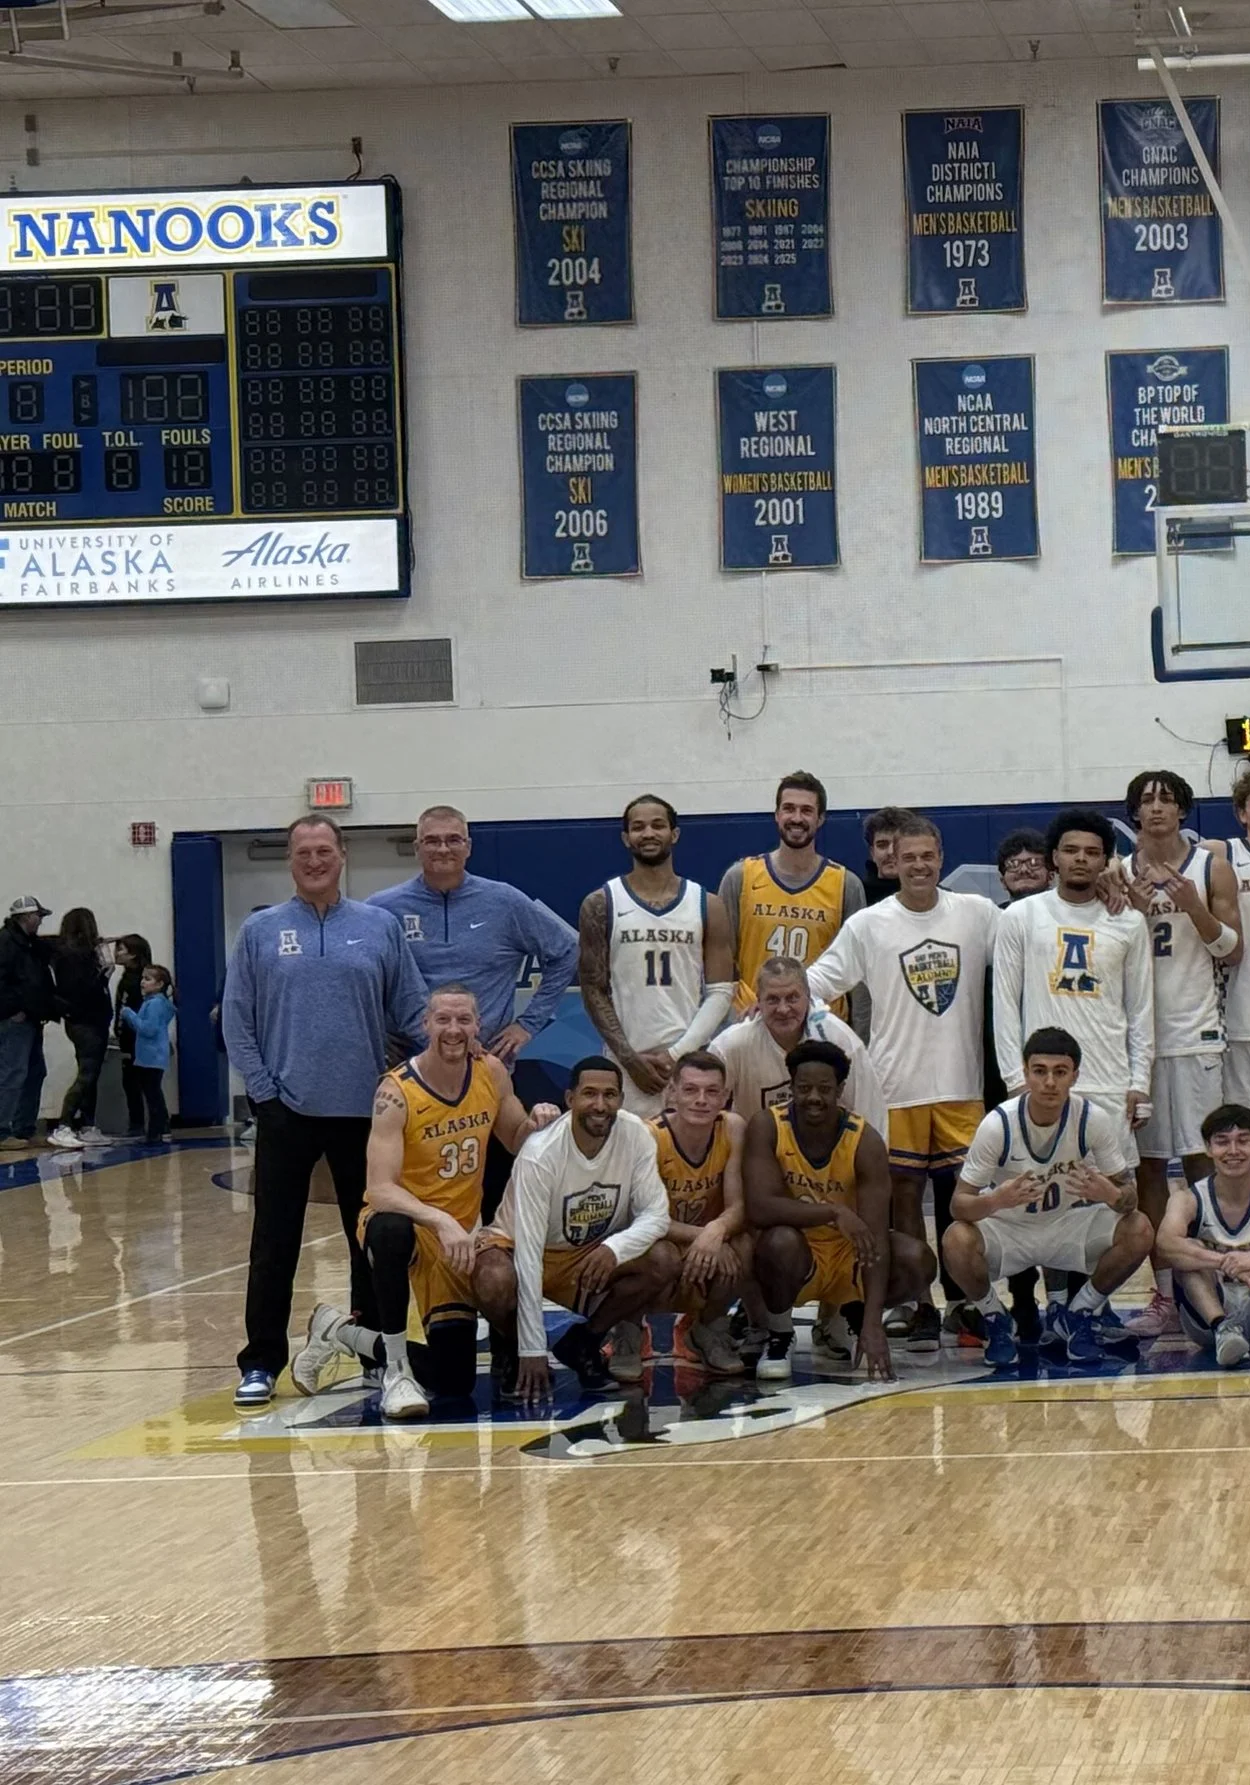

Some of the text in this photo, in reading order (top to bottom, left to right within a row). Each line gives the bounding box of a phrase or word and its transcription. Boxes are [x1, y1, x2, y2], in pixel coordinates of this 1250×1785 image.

[944, 117, 984, 134] NAIA
[948, 141, 980, 160] NAIA
[1142, 145, 1178, 164] GNAC
[532, 158, 612, 178] CCSA SKIING
[726, 157, 816, 174] CHAMPIONSHIP
[932, 162, 990, 182] DISTRICT
[724, 174, 820, 191] TOP 10 FINISHES
[1122, 166, 1200, 187] CHAMPIONS
[541, 180, 604, 200] REGIONAL
[926, 183, 1003, 204] CHAMPIONS
[540, 200, 608, 220] CHAMPION
[745, 199, 799, 219] SKIING
[1108, 194, 1213, 219] MEN'S BASKETBALL
[12, 199, 341, 259] NANOOKS
[913, 210, 1018, 236] MEN'S BASKETBALL
[562, 226, 585, 252] SKI
[1135, 223, 1189, 252] 2003
[944, 240, 990, 268] 1973
[548, 258, 602, 286] 2004
[0, 358, 54, 376] PERIOD
[958, 394, 993, 412] NCAA
[1138, 384, 1199, 405] BP TOP OF
[538, 411, 618, 430] CCSA SKIING
[754, 410, 798, 432] WEST
[924, 414, 1028, 436] NORTH CENTRAL
[1134, 405, 1205, 426] THE WORLD
[43, 434, 84, 450] FOUL
[102, 432, 144, 448] T.O.L.
[162, 429, 212, 446] FOULS
[548, 433, 611, 451] REGIONAL
[740, 436, 816, 458] REGIONAL
[945, 436, 1010, 456] REGIONAL
[546, 454, 614, 473] CHAMPION
[1118, 458, 1151, 480] MEN'S
[723, 471, 832, 494] WOMEN'S BASKETBALL
[925, 462, 1030, 488] MEN'S BASKETBALL
[568, 479, 592, 504] SKI
[4, 502, 58, 518] MATCH
[164, 497, 215, 514] SCORE
[754, 498, 804, 526] 2001
[955, 492, 1004, 521] 1989
[554, 509, 608, 538] 2006
[20, 533, 176, 551] UNIVERSITY OF
[221, 531, 350, 568] Alaska
[21, 551, 174, 578] ALASKA
[20, 579, 176, 598] FAIRBANKS
[230, 574, 340, 591] AIRLINES
[753, 903, 827, 922] ALASKA
[620, 928, 695, 944] ALASKA
[766, 924, 809, 962] 40
[645, 950, 672, 987] 11
[422, 1110, 492, 1140] ALASKA
[438, 1136, 481, 1180] 33
